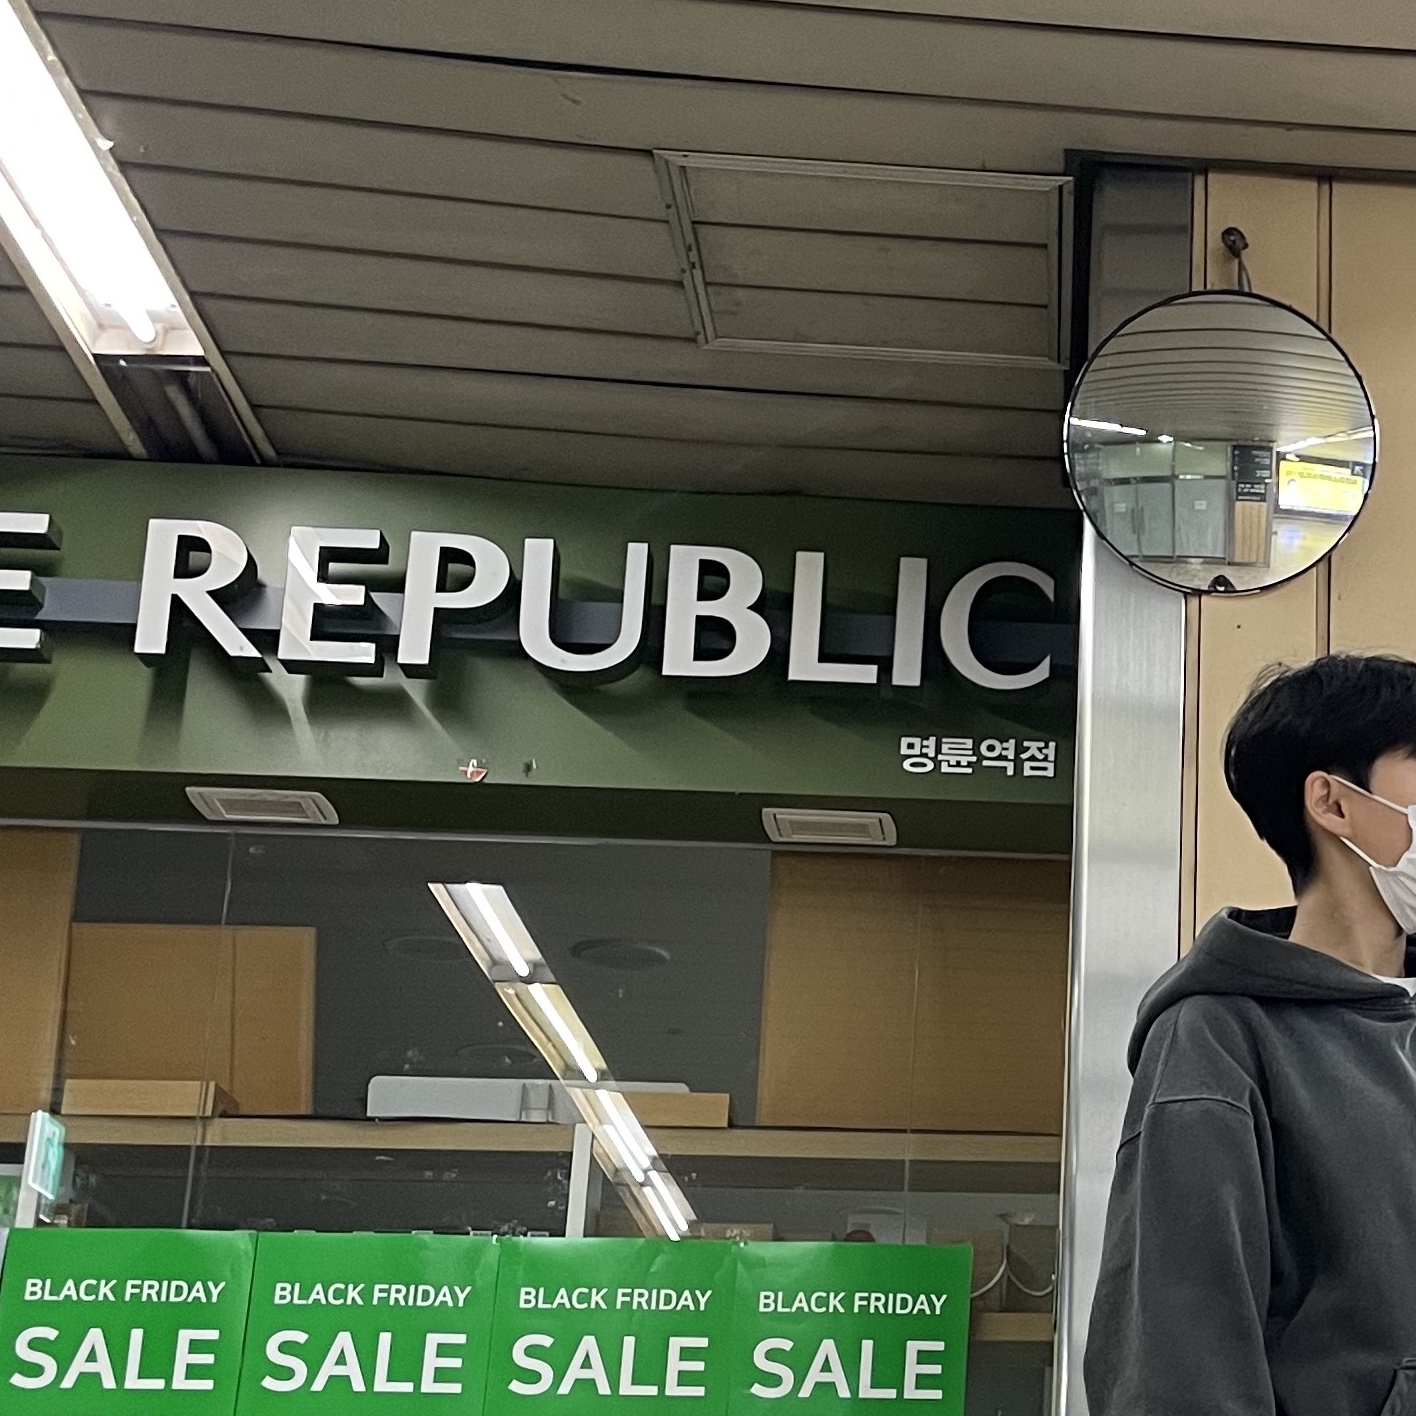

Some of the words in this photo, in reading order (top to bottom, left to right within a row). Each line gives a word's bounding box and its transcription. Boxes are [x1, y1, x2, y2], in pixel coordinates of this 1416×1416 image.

[133, 518, 1057, 690] REPUBLIC
[899, 736, 1056, 778] 명륜역점
[23, 1278, 118, 1302] BLACK
[124, 1279, 227, 1303] FRIDAY
[273, 1282, 365, 1306] BLACK
[372, 1283, 472, 1308] FRIDAY
[518, 1286, 609, 1310] BLACK
[615, 1288, 713, 1312] FRIDAY
[758, 1291, 846, 1313] BLACK
[853, 1292, 948, 1315] FRIDAY
[9, 1326, 220, 1391] SALE
[260, 1329, 467, 1394] SALE
[507, 1333, 709, 1397] SALE
[749, 1337, 945, 1400] SALE
